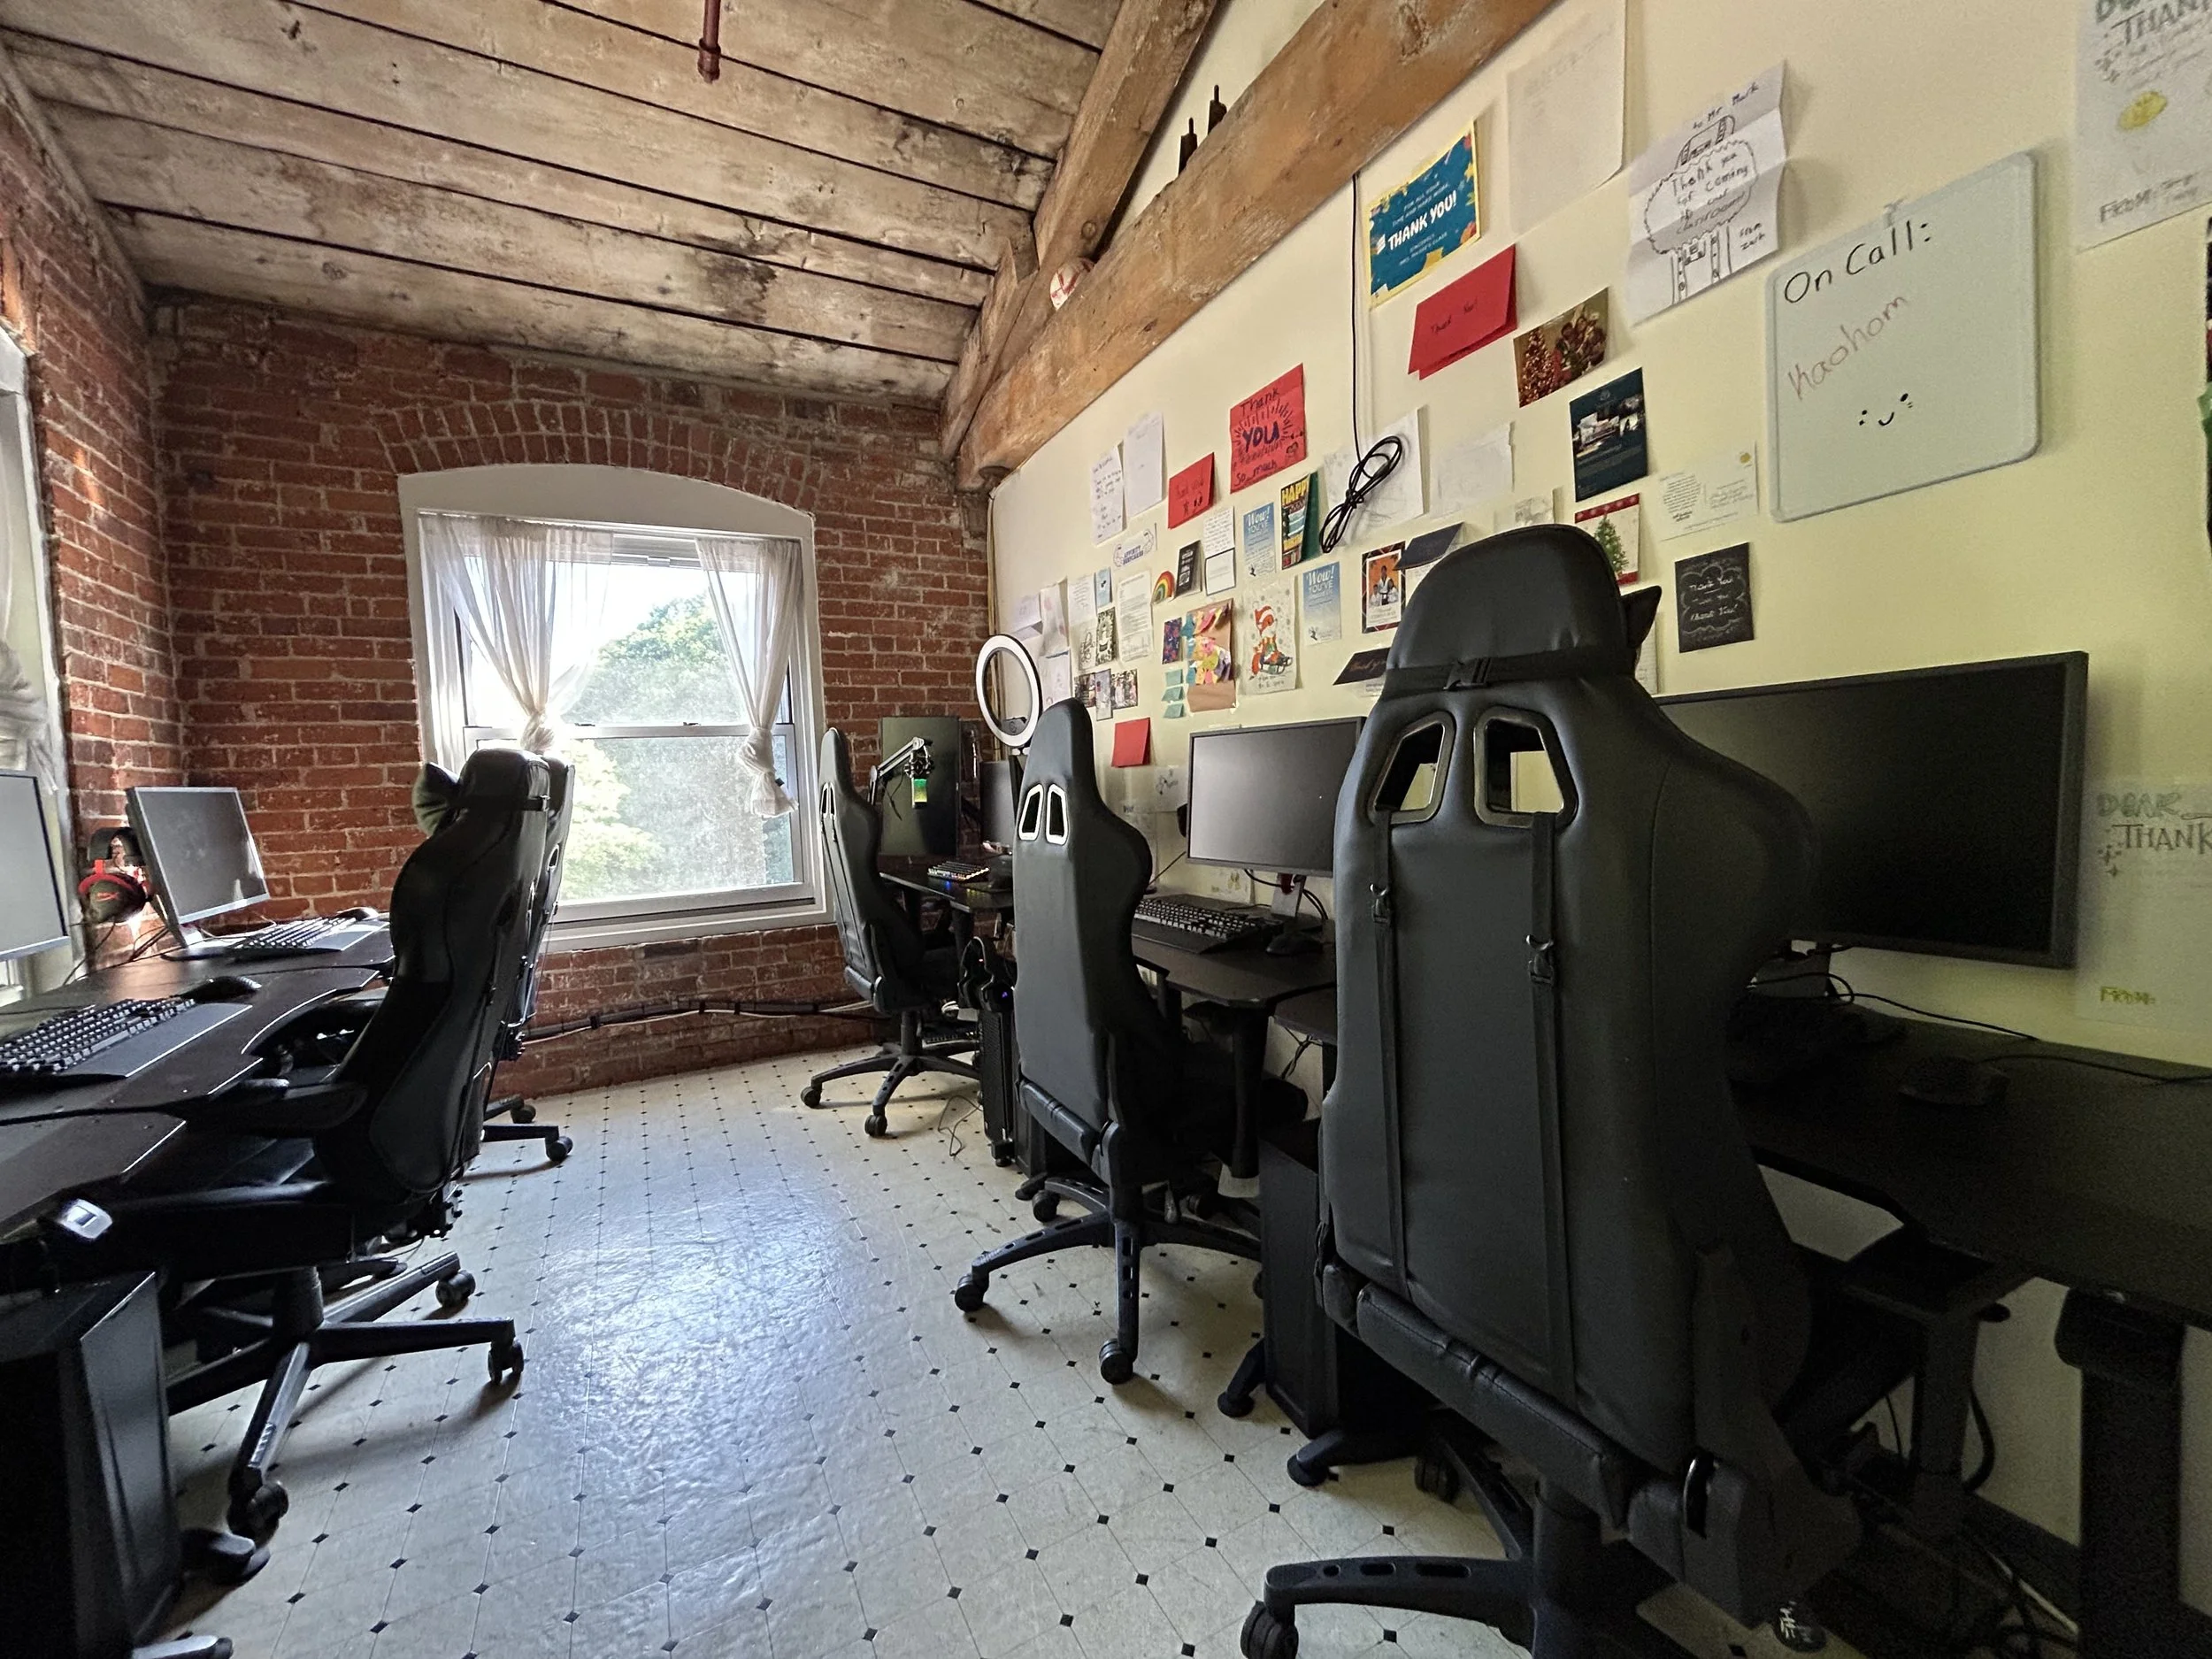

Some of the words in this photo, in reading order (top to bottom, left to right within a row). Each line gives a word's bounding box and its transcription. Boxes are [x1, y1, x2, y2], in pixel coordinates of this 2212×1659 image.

[1387, 213, 1429, 251] THANK
[1430, 189, 1457, 224] YOU!
[1784, 270, 1832, 303] On
[1846, 219, 1932, 275] Call:
[1281, 480, 1309, 506] HAPP
[1306, 565, 1335, 586] Wow!
[2111, 823, 2212, 855] THANK
